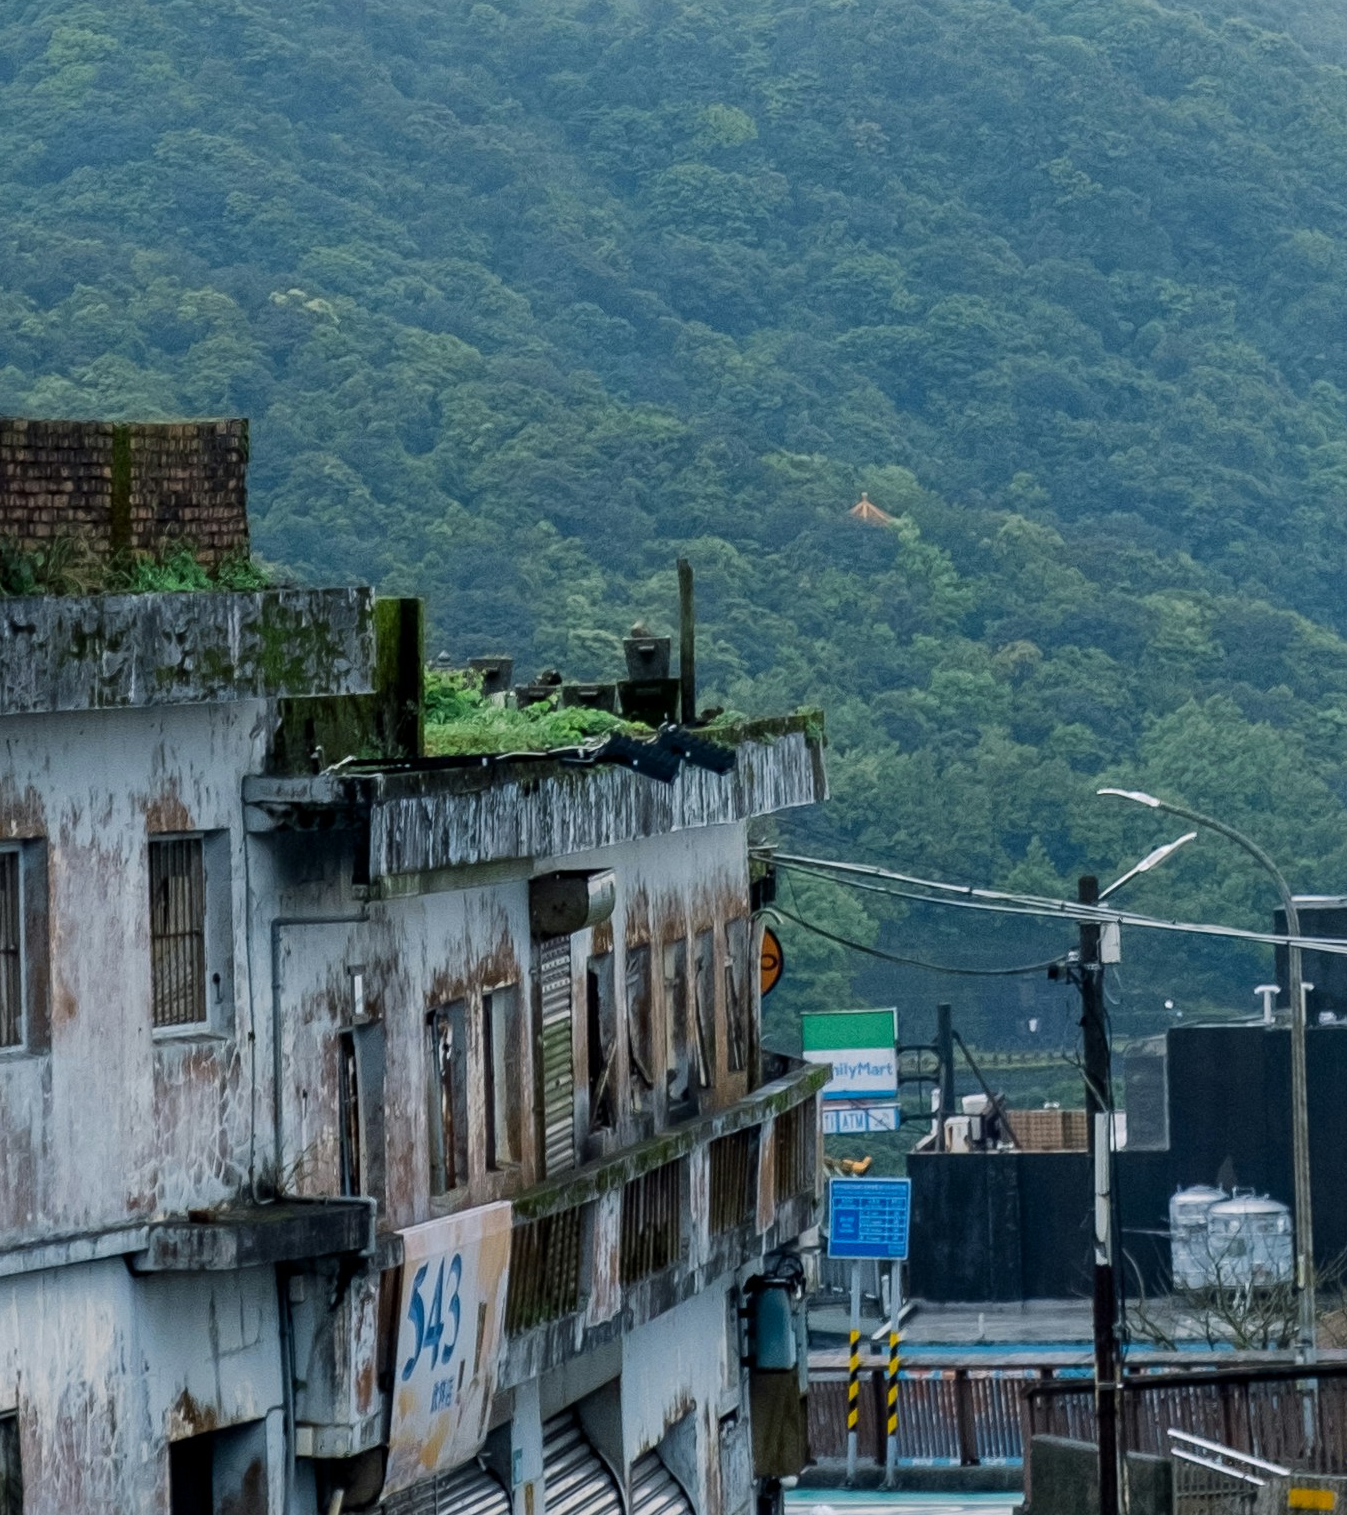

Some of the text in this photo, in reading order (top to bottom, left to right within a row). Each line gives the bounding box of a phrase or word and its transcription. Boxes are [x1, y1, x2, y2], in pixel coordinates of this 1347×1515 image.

[833, 1061, 893, 1079] ilyMart
[842, 1113, 863, 1130] ATM
[401, 1253, 462, 1382] 543
